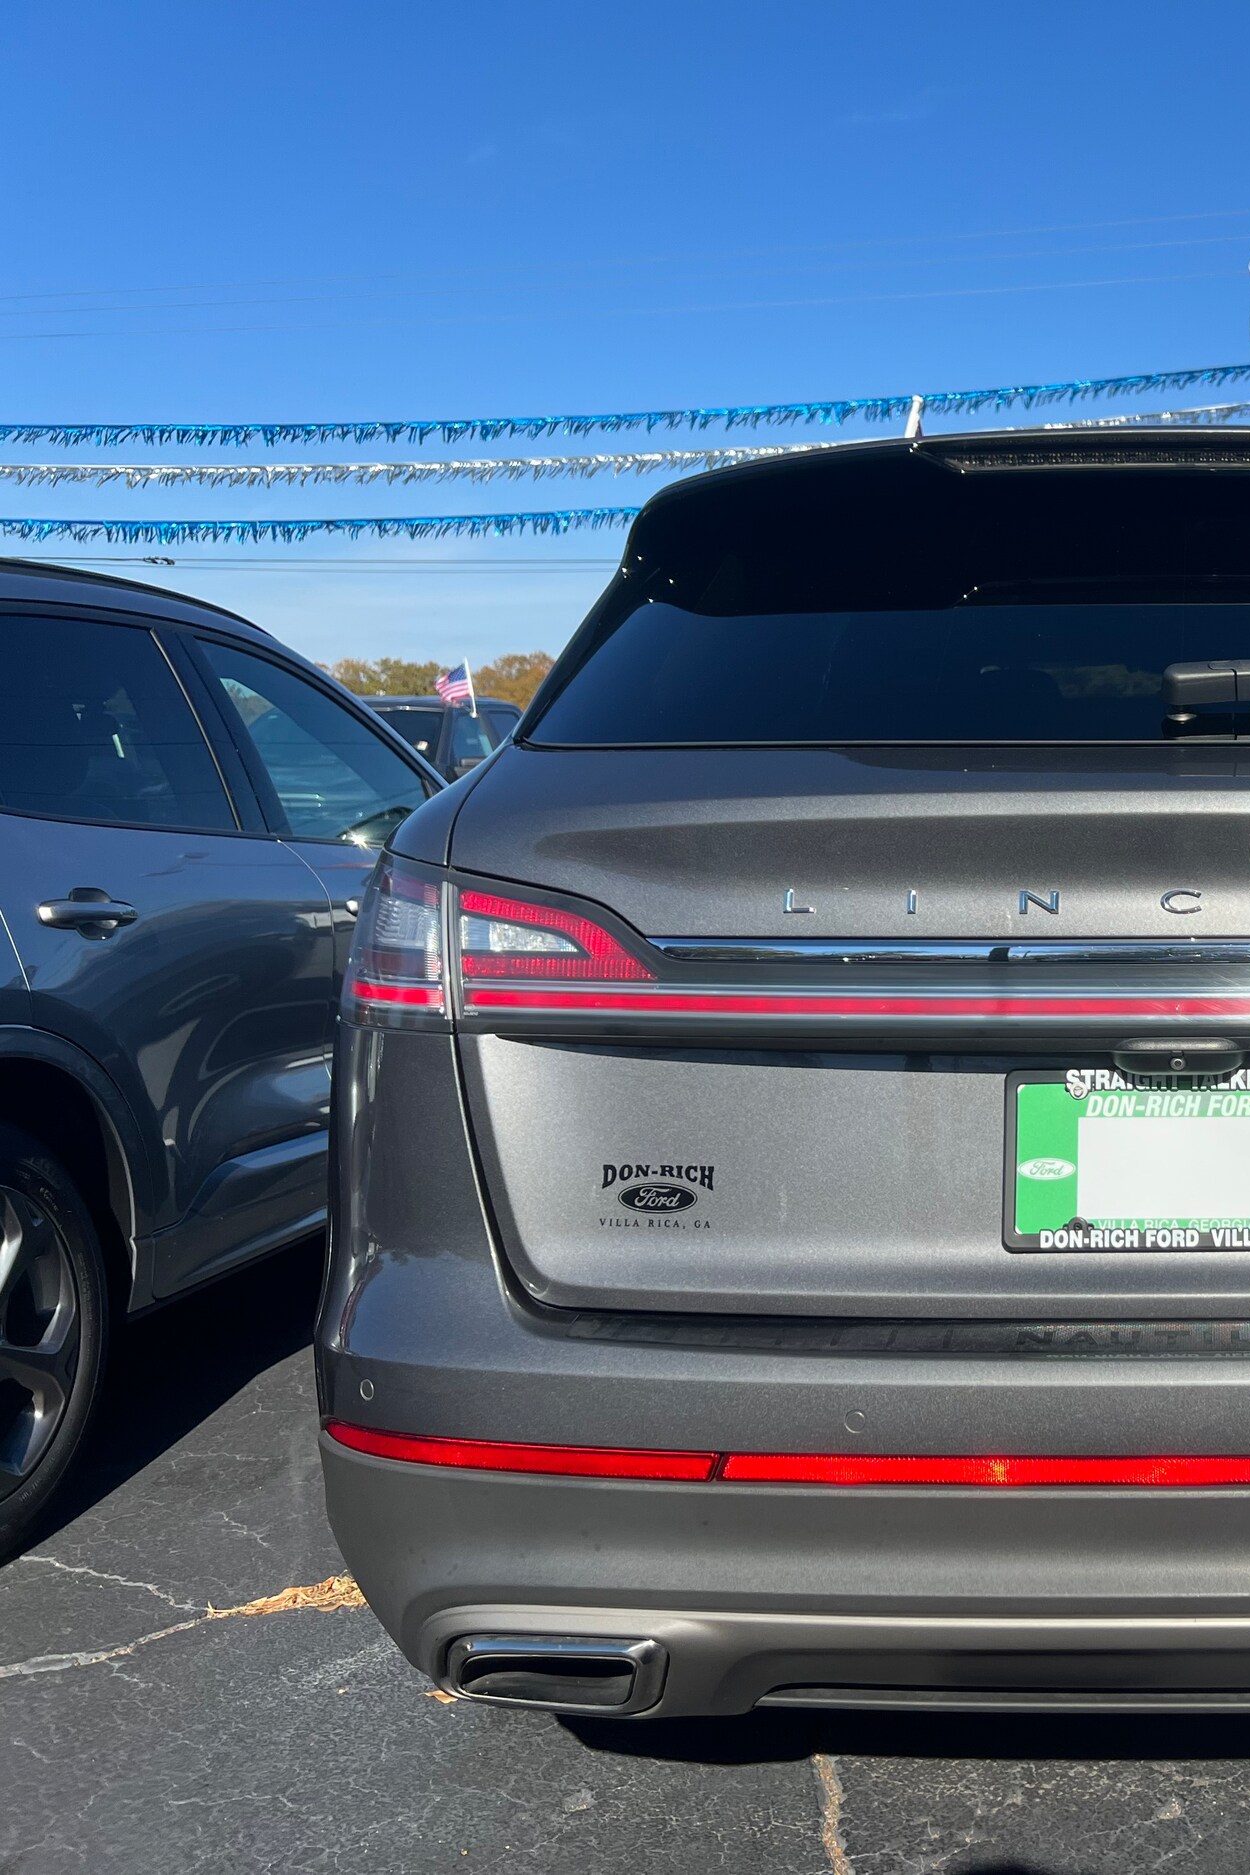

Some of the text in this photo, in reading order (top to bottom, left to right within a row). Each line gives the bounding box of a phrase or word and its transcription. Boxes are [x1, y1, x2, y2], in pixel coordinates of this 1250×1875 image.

[1085, 1094, 1201, 1118] DON-RICH
[602, 1164, 715, 1191] DON-RICH
[1029, 1160, 1065, 1176] Ford
[634, 1186, 681, 1207] Ford
[599, 1218, 711, 1230] VILLA RICA, GA
[1039, 1228, 1139, 1248] DON-RICH
[1145, 1228, 1200, 1248] FORD
